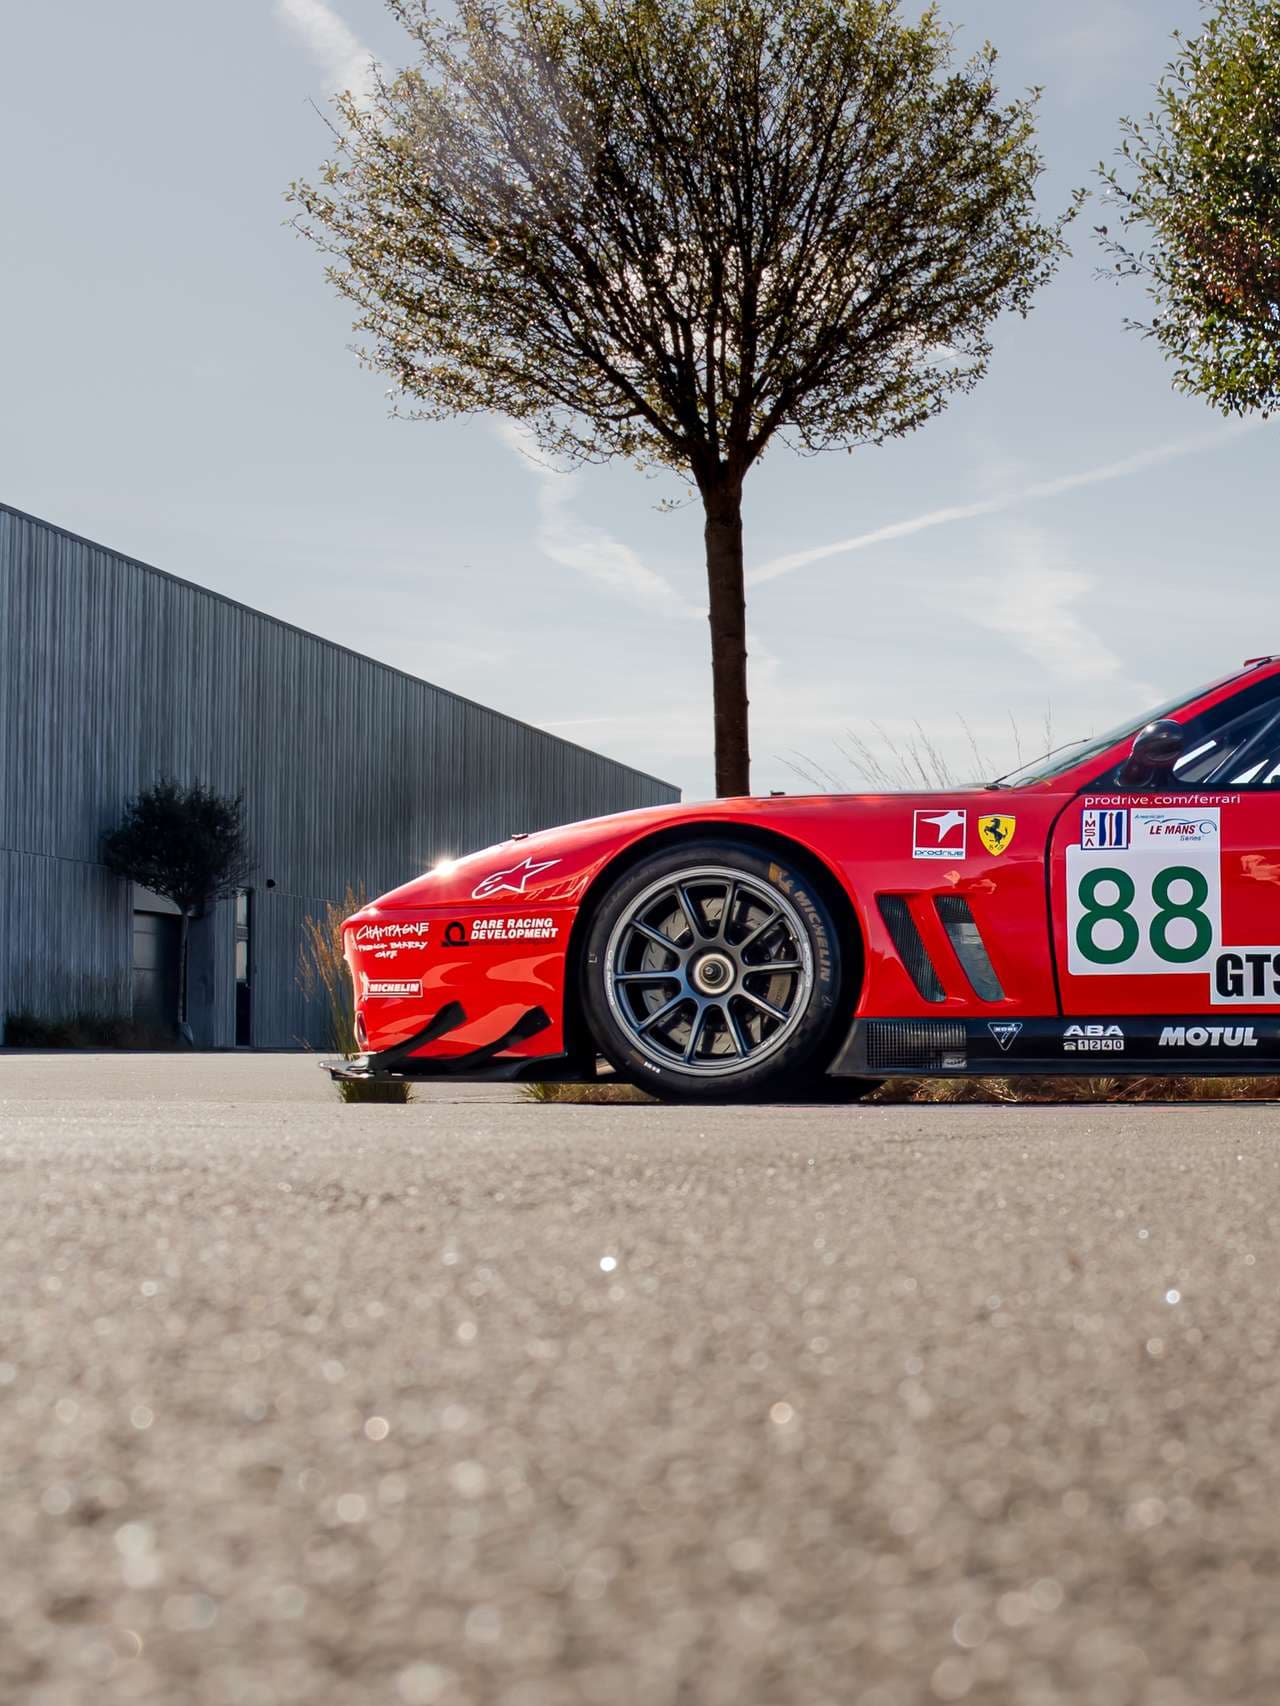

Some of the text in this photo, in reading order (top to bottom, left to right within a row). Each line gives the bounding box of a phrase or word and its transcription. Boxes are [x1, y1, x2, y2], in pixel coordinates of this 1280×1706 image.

[1085, 794, 1241, 807] prodrive.com/ferrari
[1149, 824, 1195, 835] LE MANS
[1076, 866, 1213, 965] 88
[472, 917, 553, 930] CARE RACING
[356, 922, 429, 941] CHAMPAGNE
[470, 927, 559, 940] DEVELOPMENT
[794, 890, 831, 982] MICHELIN
[369, 983, 420, 993] MICHELIN
[1063, 1025, 1124, 1036] ABA
[1158, 1026, 1259, 1047] MOTUL
[1078, 1040, 1124, 1050] 1240
